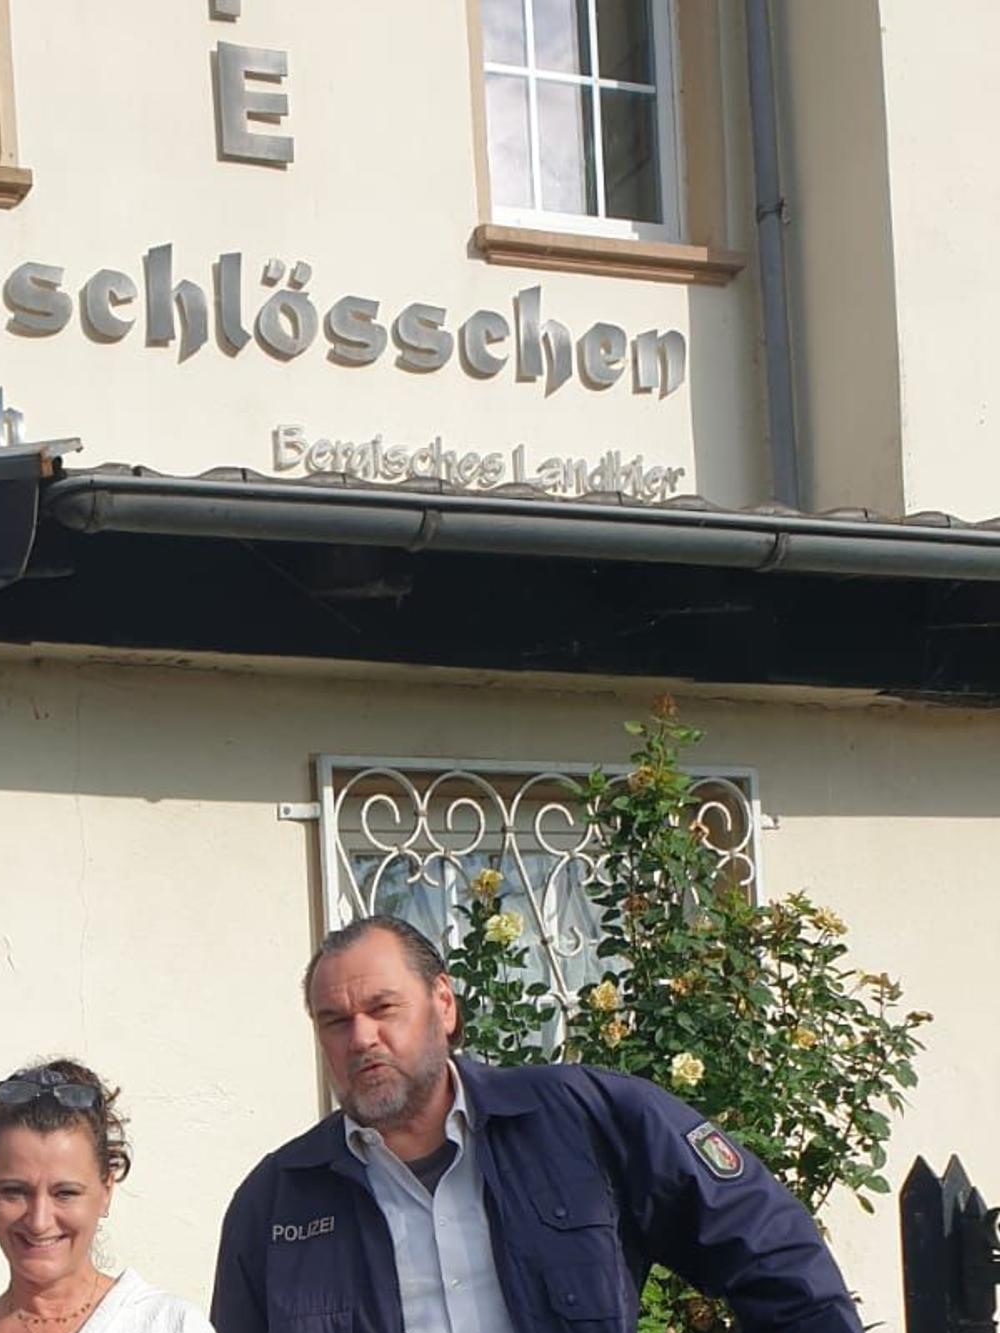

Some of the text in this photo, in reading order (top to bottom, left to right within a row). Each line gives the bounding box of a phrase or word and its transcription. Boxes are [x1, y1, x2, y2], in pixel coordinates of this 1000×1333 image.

[208, 0, 294, 170] E
[272, 424, 686, 505] Bergisches Landbier
[271, 1215, 335, 1242] POLIZEI
